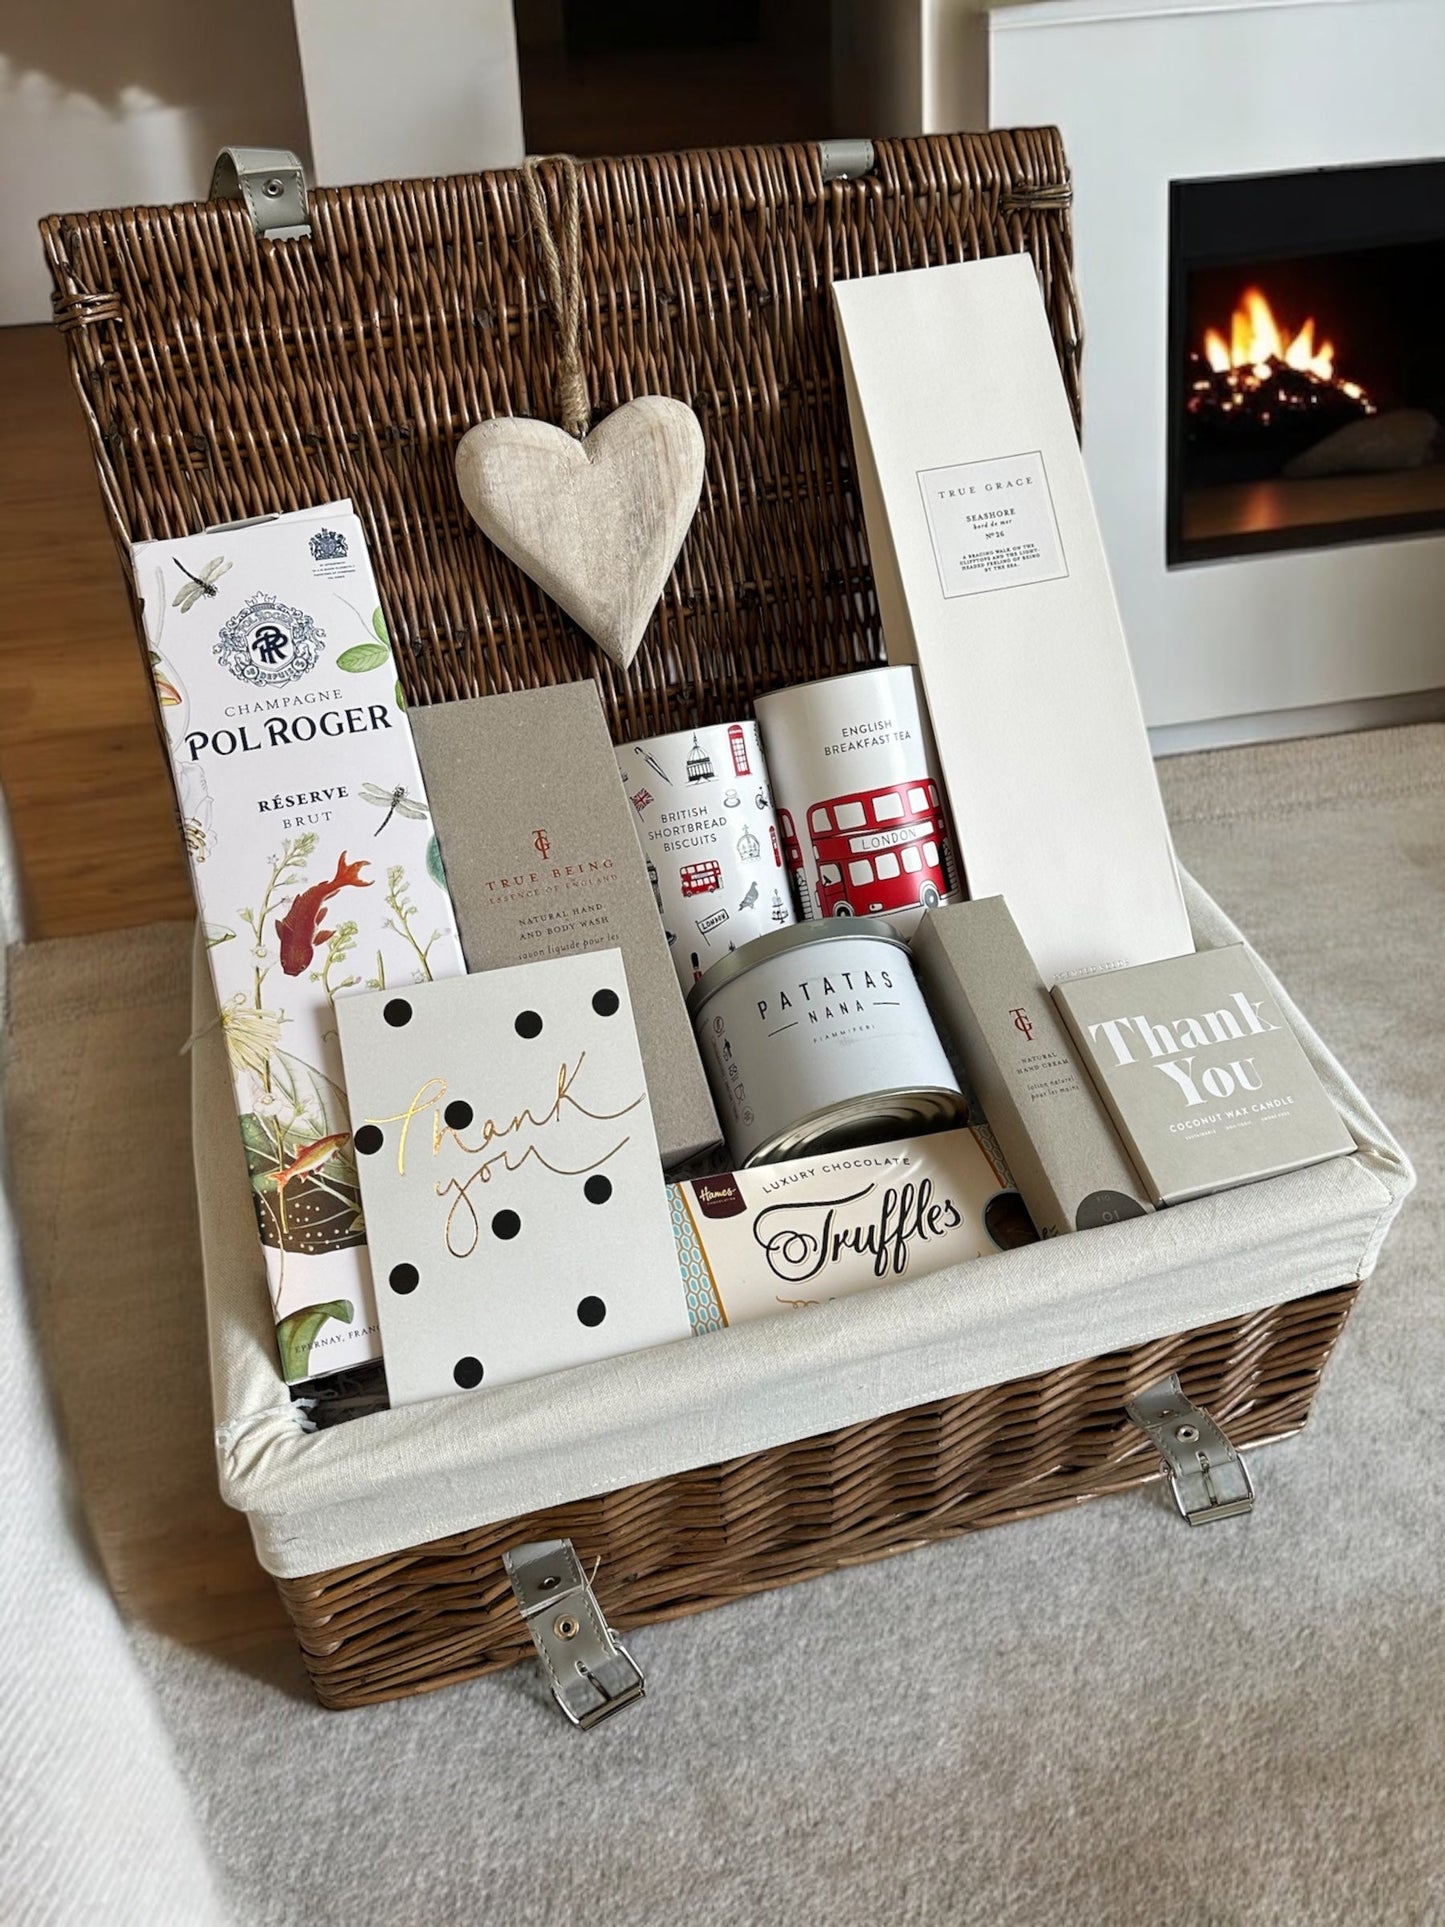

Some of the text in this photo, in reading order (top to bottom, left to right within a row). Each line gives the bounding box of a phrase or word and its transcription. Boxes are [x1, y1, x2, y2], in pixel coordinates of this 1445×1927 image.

[938, 476, 1033, 499] TRUE GRACE
[966, 508, 1016, 523] SEASHORE
[224, 688, 342, 718] CHAMPAGNE
[184, 704, 392, 761] POL ROGER
[842, 720, 892, 738] ENGLISH
[824, 730, 911, 756] BREAKFAST TEA
[258, 786, 350, 812] RÉSERVE
[282, 811, 332, 829] BRUT
[661, 806, 708, 824] BRITISH
[648, 816, 727, 840] SHORTBREAD
[862, 828, 917, 850] LONDON
[664, 834, 716, 852] BISCUITS
[485, 859, 614, 891] TRUE BEING
[518, 904, 603, 926] NATURAL HAND
[520, 916, 609, 941] AND BODY WASH
[582, 937, 604, 950] pour
[758, 970, 893, 1020] PATATAS
[808, 1000, 864, 1024] NANA
[1088, 992, 1282, 1067] Thank
[1016, 1058, 1068, 1074] HAND CREAM
[1021, 1052, 1057, 1063] NATURAL
[1153, 1056, 1263, 1107] You
[364, 1051, 646, 1176] Thank
[1169, 1113, 1222, 1133] COCONUT
[1224, 1107, 1249, 1119] WAX
[1251, 1095, 1295, 1113] CANDLE
[762, 1157, 911, 1194] LUXURY CHOCOLATE
[435, 1136, 630, 1258] you
[699, 1186, 736, 1202] Hames
[754, 1177, 962, 1282] Truffles
